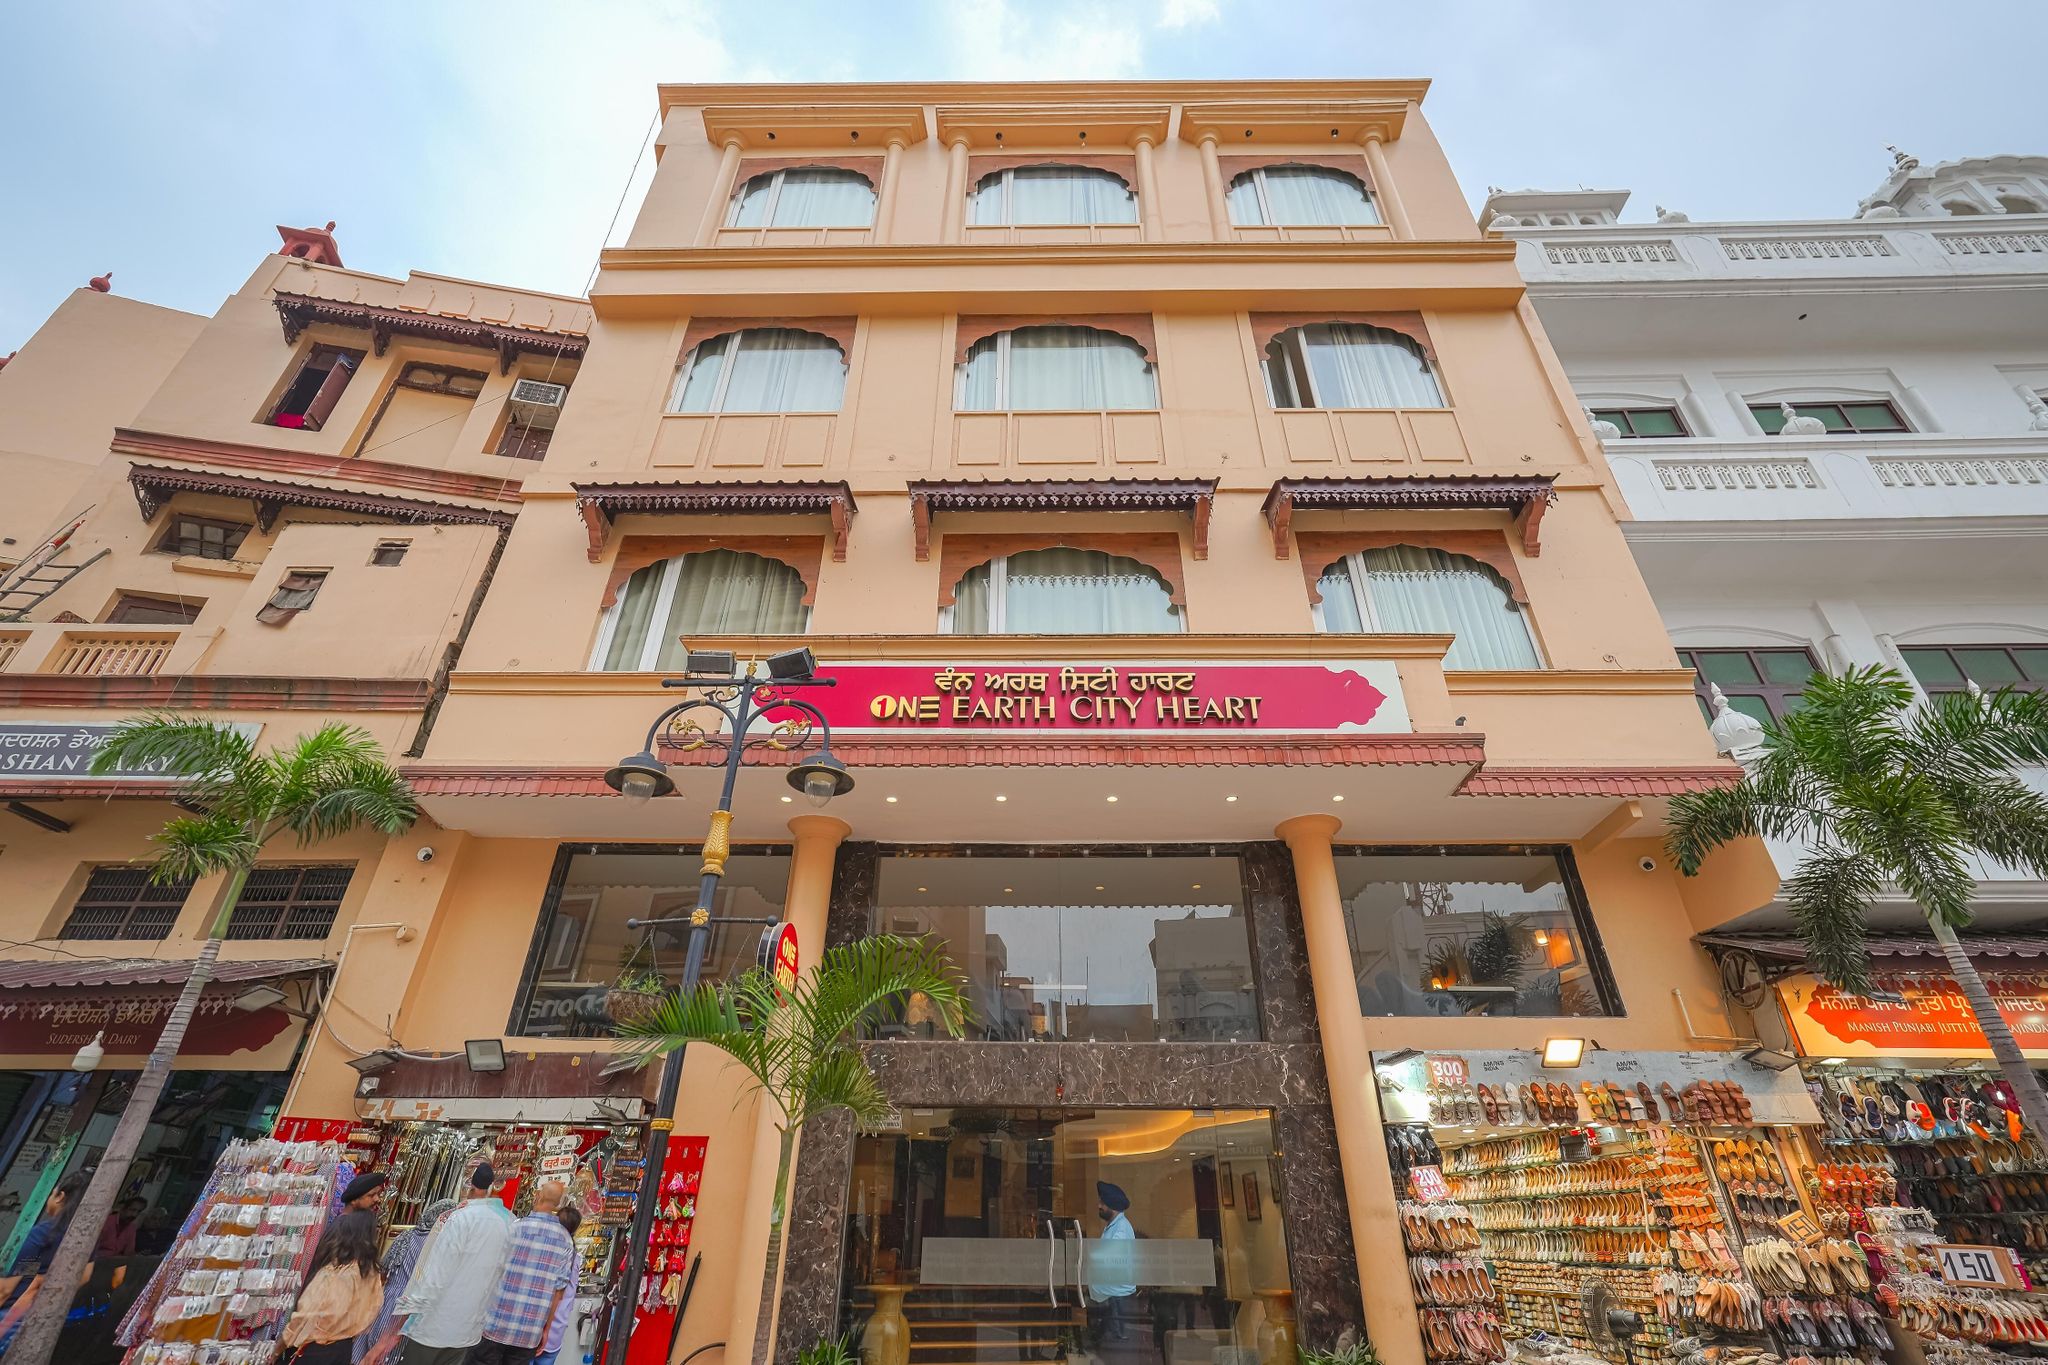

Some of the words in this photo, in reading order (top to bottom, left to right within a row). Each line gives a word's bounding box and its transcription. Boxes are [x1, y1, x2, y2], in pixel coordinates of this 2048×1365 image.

[1059, 667, 1119, 694] ਸਿਟੀ
[1128, 672, 1196, 692] ਹਾਰਟ
[952, 696, 1056, 721] EARTH
[1070, 696, 1142, 722] CITY
[1156, 696, 1262, 723] HEART
[0, 733, 66, 748] ਦਰਸ਼ਨ
[0, 754, 82, 771] SHAN
[782, 936, 797, 967] ONE
[775, 957, 796, 995] EARTH
[1847, 1021, 1891, 1033] MANISH
[1892, 1021, 1937, 1035] PUNJABI
[1938, 1022, 1969, 1035] JUTTI
[46, 1033, 107, 1045] SUDERSHN
[108, 1033, 141, 1045] DAIRY
[1432, 1061, 1463, 1077] 300
[1415, 1169, 1442, 1186] 200
[1787, 1215, 1820, 1240] 150
[1943, 1252, 1996, 1282] 150
